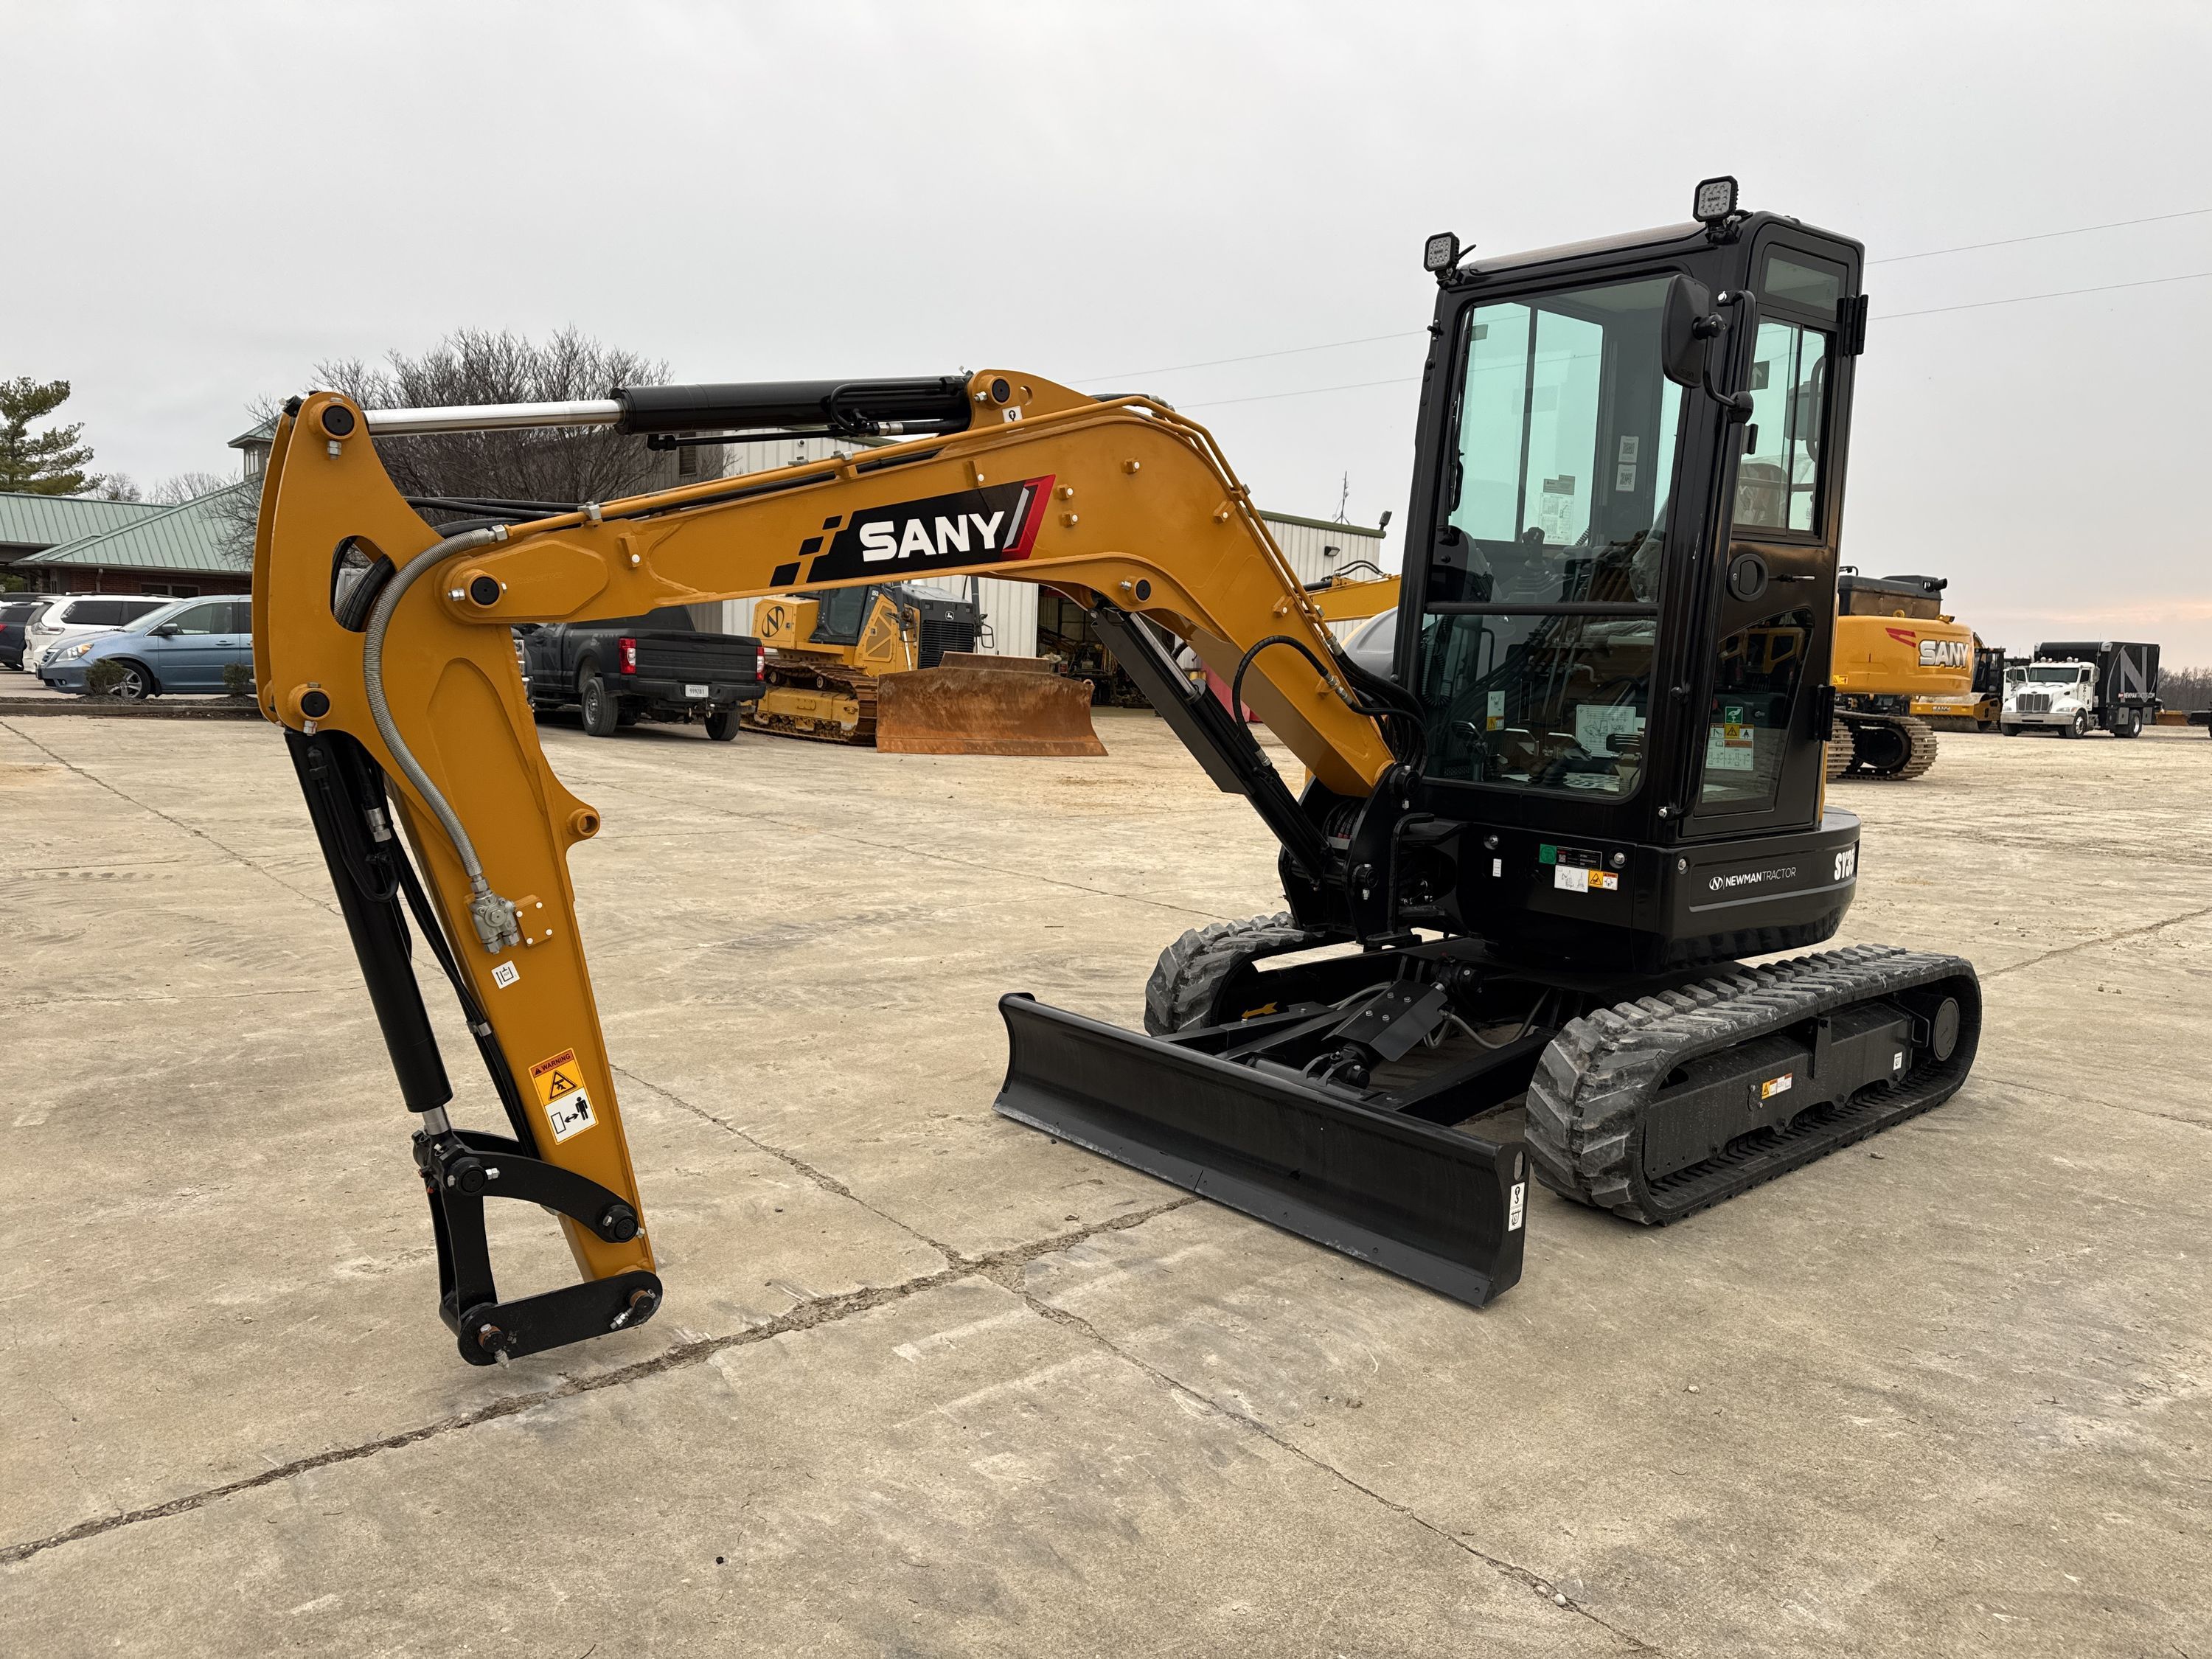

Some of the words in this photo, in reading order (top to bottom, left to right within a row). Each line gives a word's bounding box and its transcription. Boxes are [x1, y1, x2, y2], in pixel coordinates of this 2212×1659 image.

[859, 510, 1005, 562] SANY
[1919, 639, 1969, 668] SANY
[1725, 866, 1797, 888] NEWMANTRACTOR
[541, 1053, 571, 1071] WARNING
